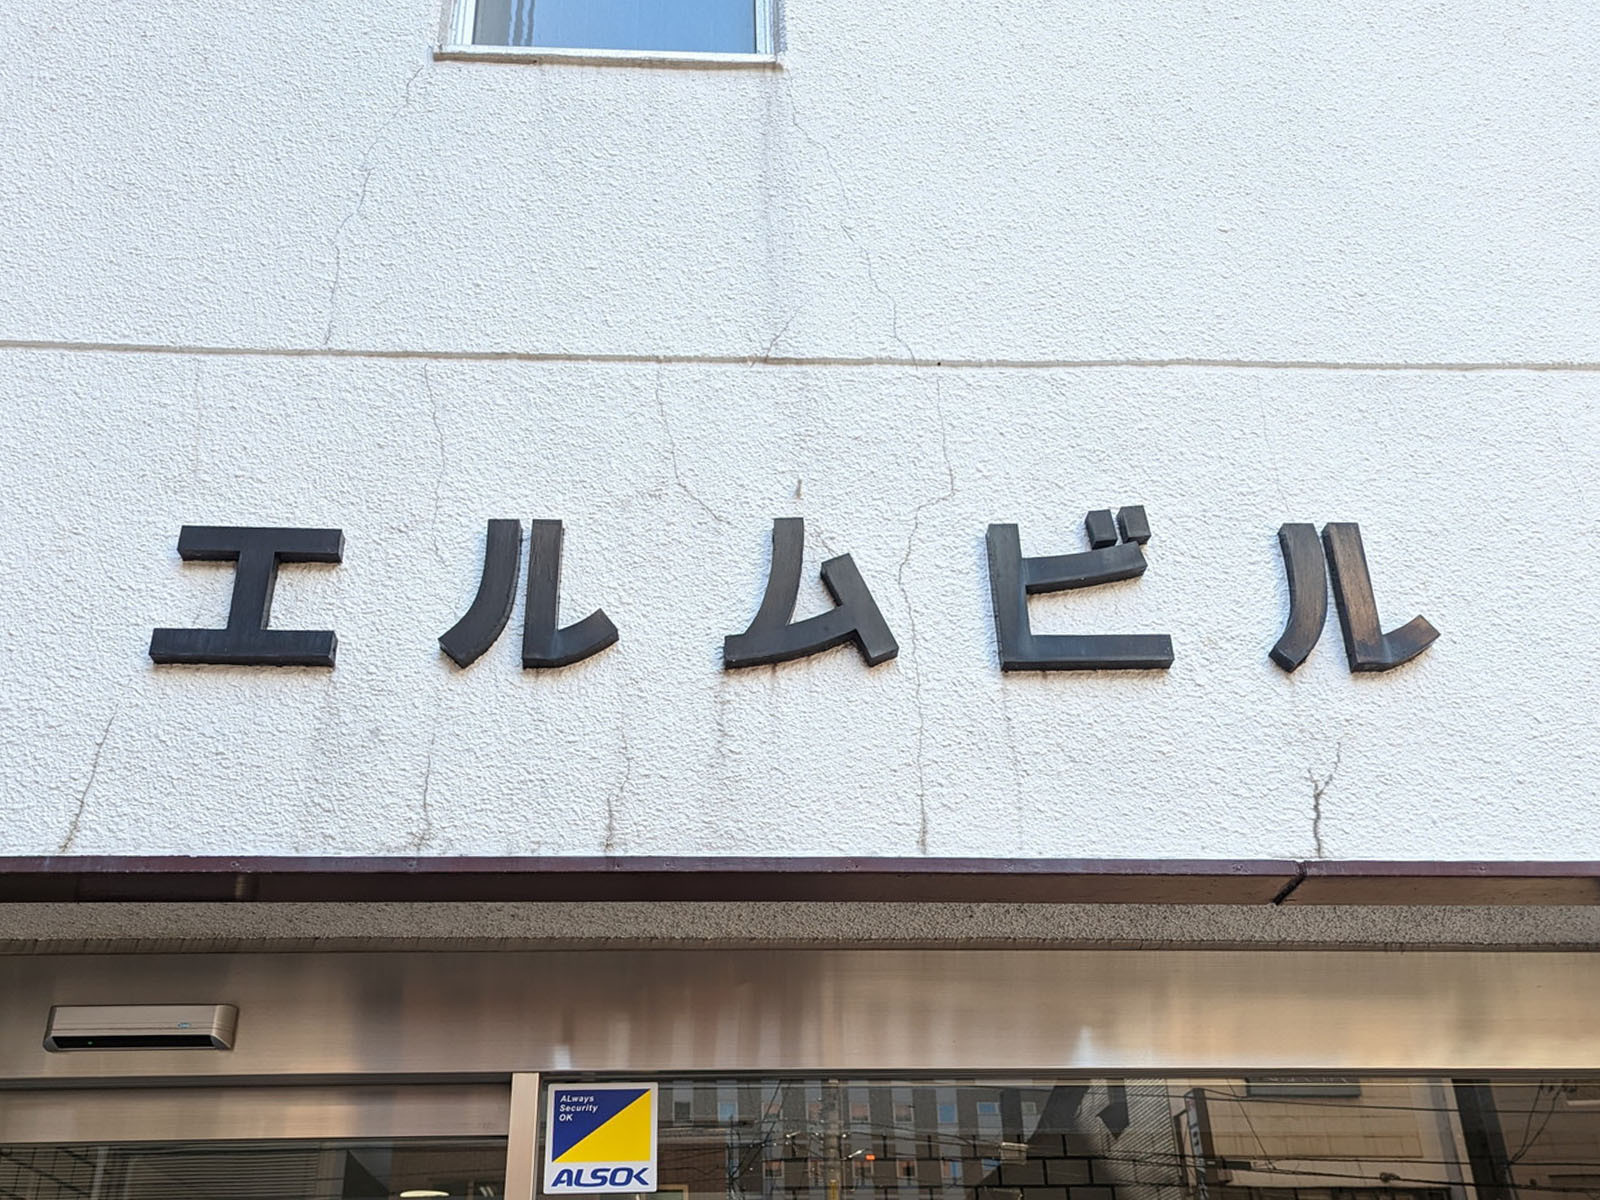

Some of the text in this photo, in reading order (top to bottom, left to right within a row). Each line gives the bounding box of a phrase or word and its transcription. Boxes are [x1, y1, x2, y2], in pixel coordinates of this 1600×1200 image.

[149, 505, 1441, 673] エルムビル
[559, 1104, 598, 1113] Security
[558, 1113, 573, 1122] OK
[551, 1167, 649, 1187] ALSOK
